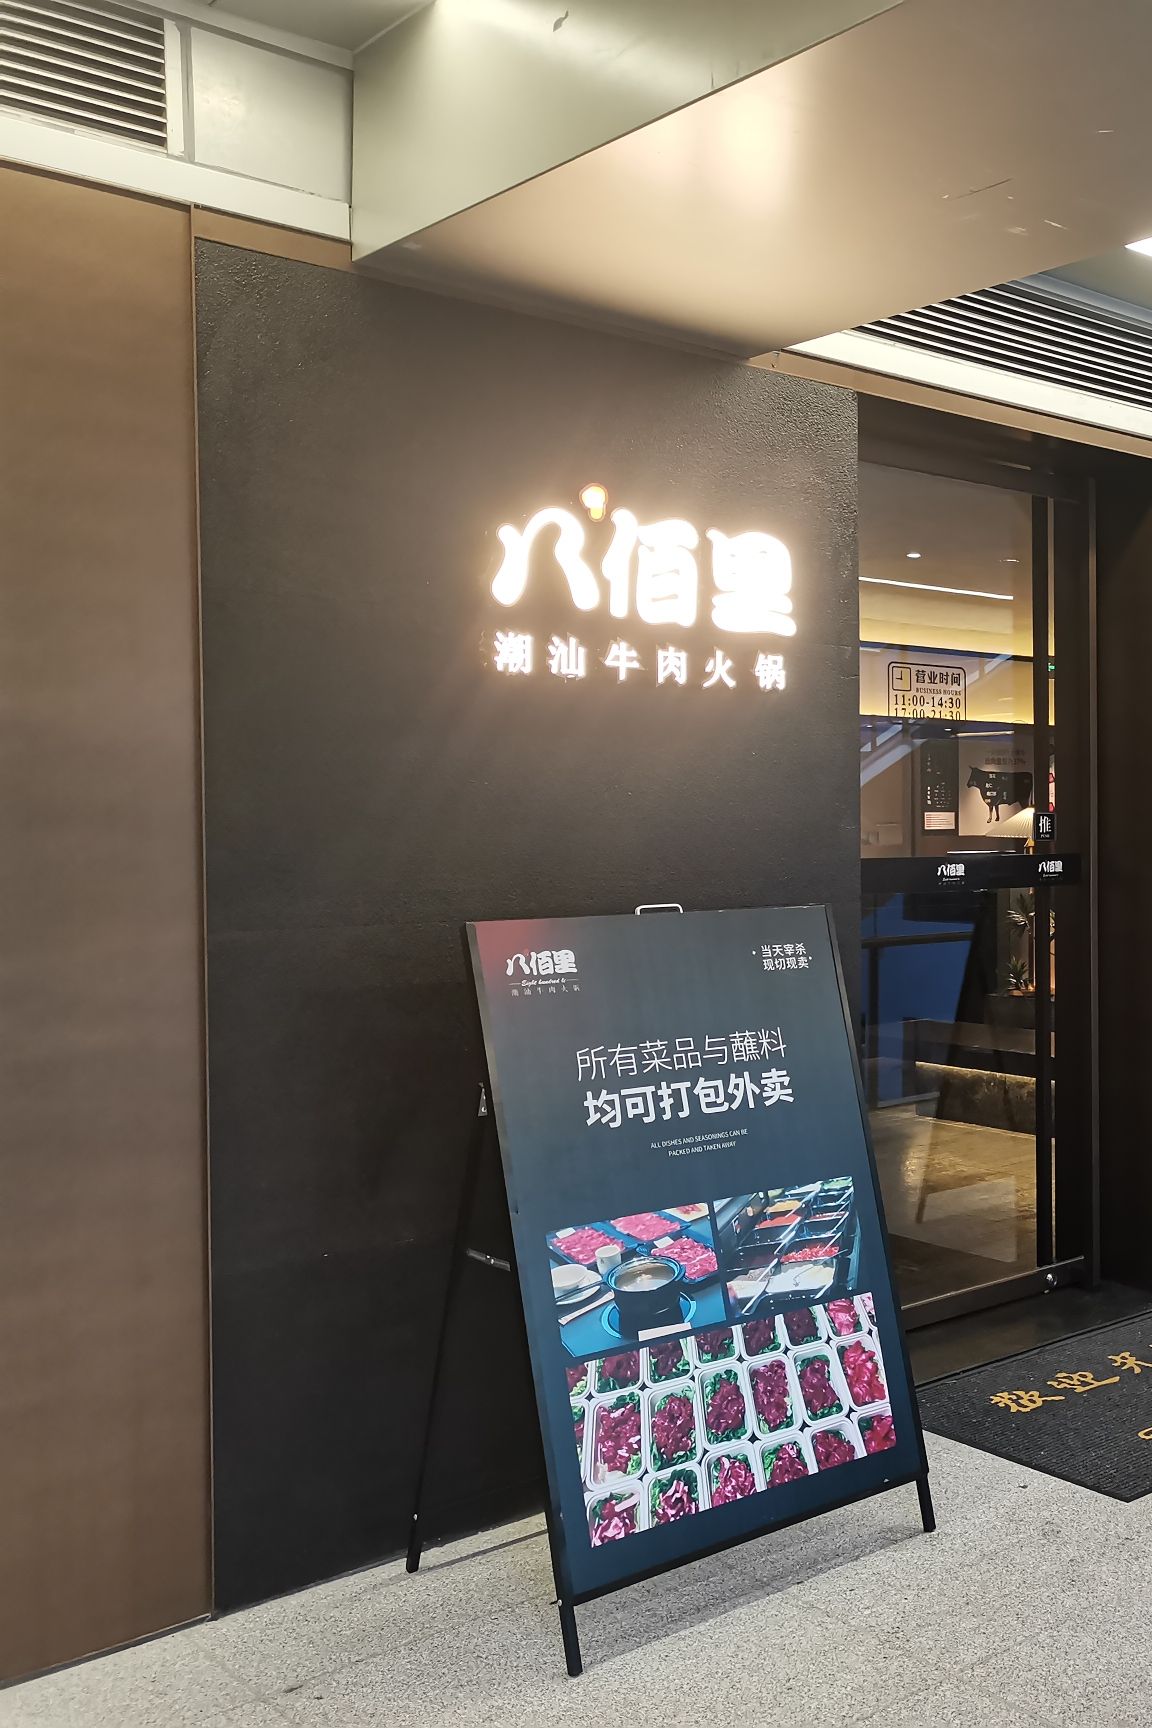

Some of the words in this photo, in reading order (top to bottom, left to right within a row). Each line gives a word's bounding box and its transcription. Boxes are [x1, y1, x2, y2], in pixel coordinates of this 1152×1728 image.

[491, 507, 797, 637] 八佰里
[493, 631, 787, 691] 潮汕牛肉火锅
[915, 669, 961, 687] 营业时间
[916, 687, 942, 695] BUSINESS
[894, 694, 961, 709] 11:00-14:30
[1039, 815, 1052, 833] 推
[760, 942, 807, 957] 当天宰杀
[506, 949, 578, 976] 八佰里
[762, 956, 809, 971] 现切现卖
[576, 1026, 787, 1082] 所有菜品与蘸料
[583, 1067, 795, 1129] 均可打包外卖
[661, 1138, 682, 1148] DISHES
[683, 1136, 695, 1144] AND
[694, 1131, 729, 1142] SEASONINGS
[729, 1129, 741, 1137] CAN
[668, 1148, 690, 1157] PACKED
[691, 1145, 703, 1153] AND
[703, 1143, 721, 1151] TAKEN
